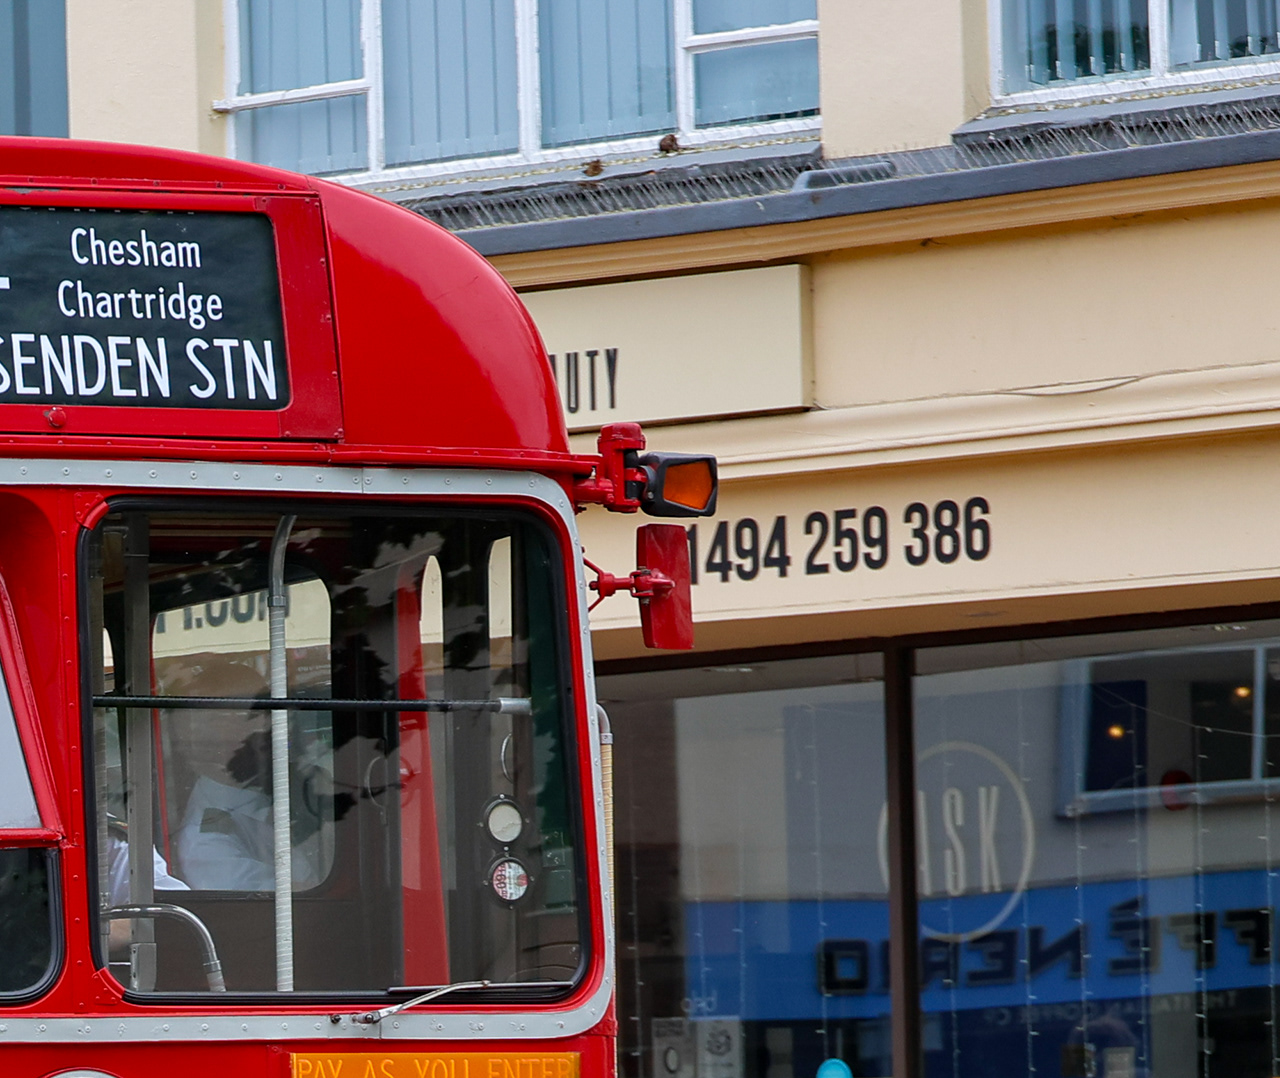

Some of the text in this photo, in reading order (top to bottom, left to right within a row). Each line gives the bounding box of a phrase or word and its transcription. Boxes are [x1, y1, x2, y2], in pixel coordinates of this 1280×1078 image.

[70, 228, 201, 268] Chesham
[57, 279, 223, 330] Chartridge
[185, 337, 278, 400] STN
[804, 506, 889, 575] 259
[904, 497, 990, 566] 386
